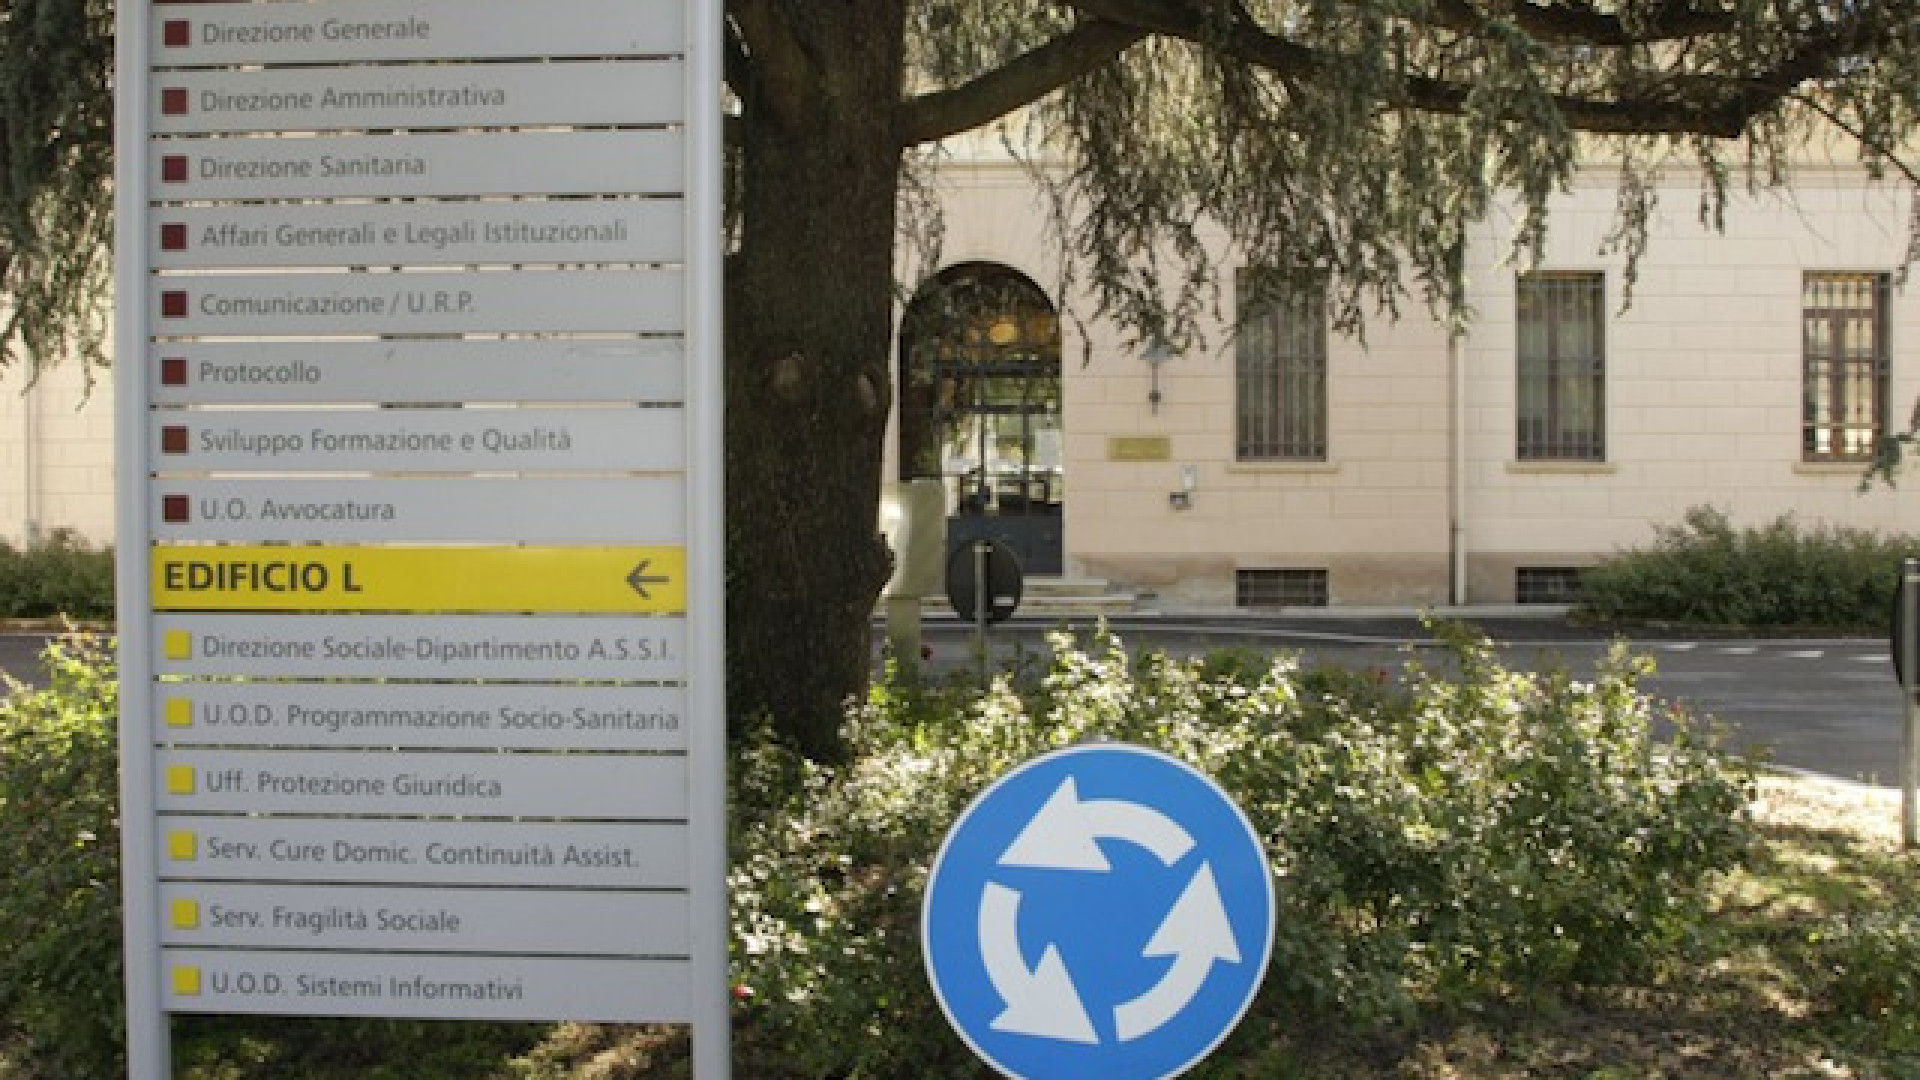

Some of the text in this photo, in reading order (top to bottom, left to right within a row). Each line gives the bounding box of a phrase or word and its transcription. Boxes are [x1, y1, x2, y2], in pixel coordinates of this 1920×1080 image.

[202, 18, 429, 44] Direzione Generale
[200, 86, 505, 111] Direzione Amministrativa
[200, 155, 425, 178] Direzione Sanitaria
[202, 220, 627, 250] Affari Generali e Legali Istituzionali
[201, 291, 474, 315] Comunicazione / U.R.P.
[200, 362, 320, 383] Protocollo
[200, 428, 571, 455] Sviluppo Formazione e Qualità
[201, 499, 395, 520] U.O. Avvocatura
[165, 562, 361, 592] EDIFICIO L
[203, 636, 674, 662] Direzione Sociale-Dipartimento A.S.S.I.
[204, 705, 678, 732] U.O.D. Programmazione Socio-Sanitaria
[206, 772, 501, 798] Uff. Protezione Giuridica
[208, 838, 639, 868] Serv. Cure Domic. Continuità Assist.
[210, 906, 459, 933] Serv. Fragilità Sociale
[212, 972, 522, 1000] U.O.D. Sistemi Informativi
